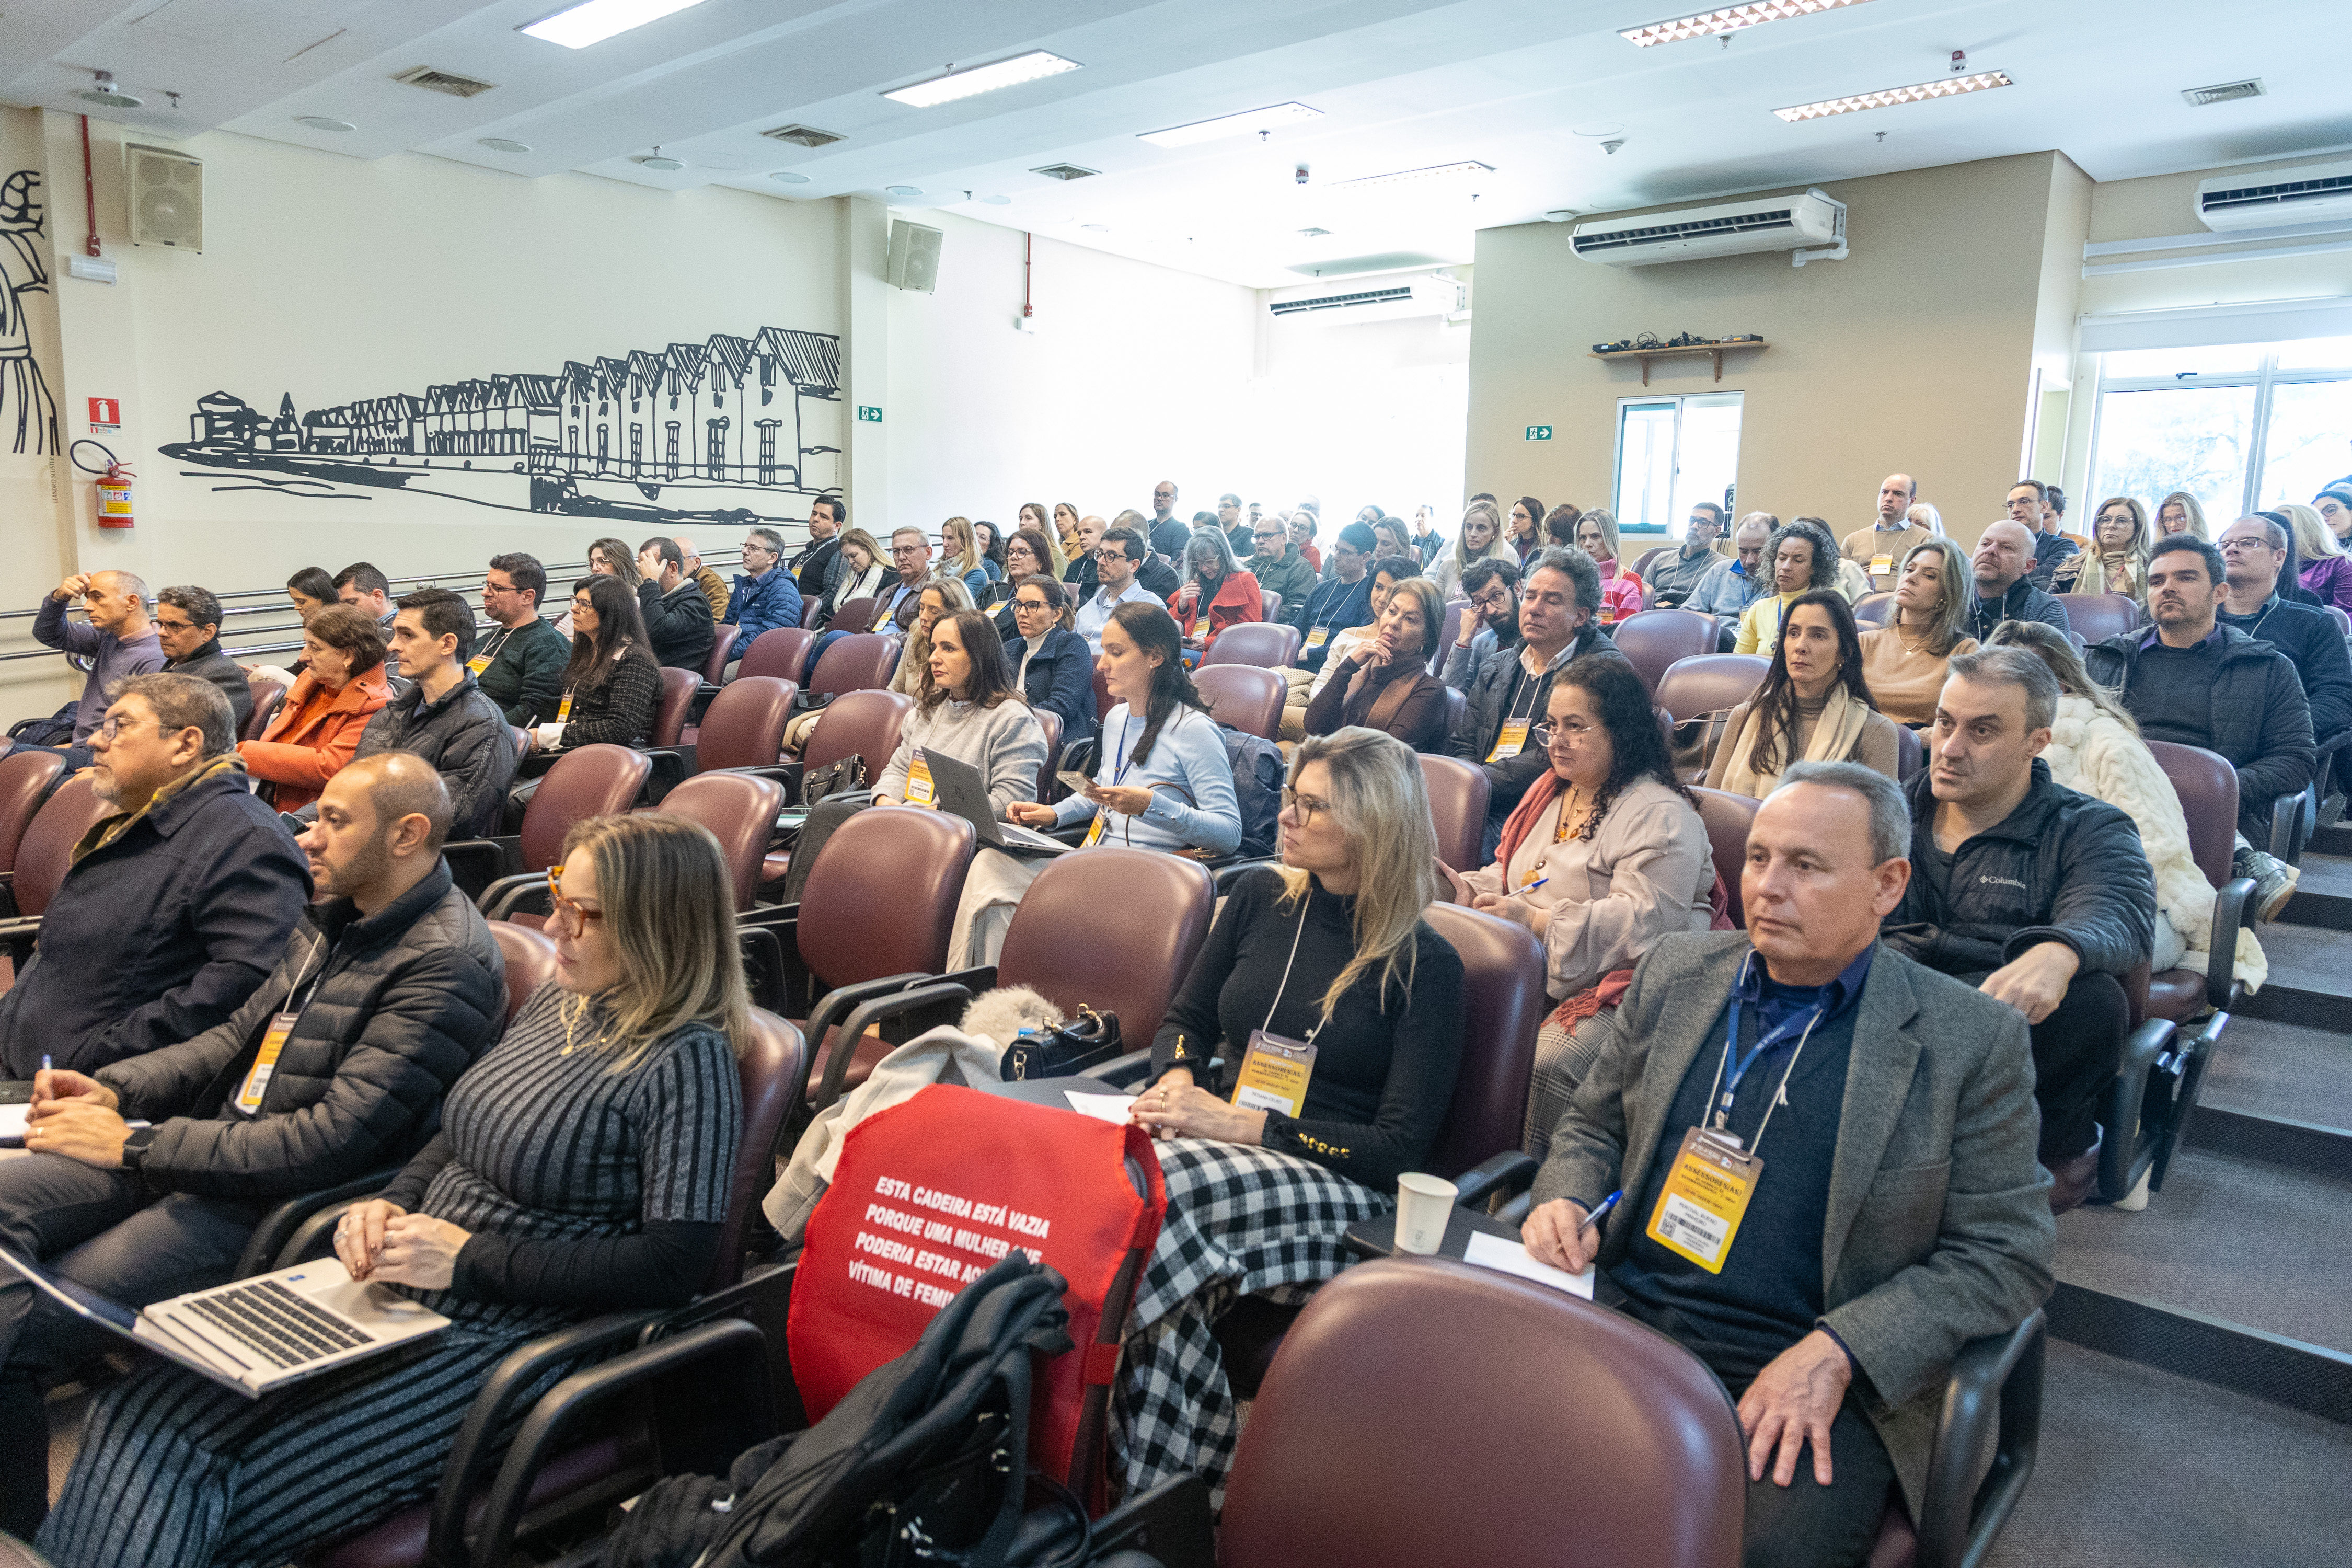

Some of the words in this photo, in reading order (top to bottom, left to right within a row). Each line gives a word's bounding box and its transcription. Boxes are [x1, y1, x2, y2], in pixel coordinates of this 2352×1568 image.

[1988, 875, 2026, 889] Columbia
[1683, 1163, 1743, 1197] ASSESSORES(AS)
[875, 1176, 911, 1201] ESTA
[913, 1186, 972, 1218] CADEIRA
[971, 1205, 1008, 1227] ESTÁ
[1008, 1210, 1050, 1239] VAZIA
[865, 1203, 925, 1236] PORQUE
[924, 1221, 953, 1244] UMA
[953, 1229, 1010, 1259] MULHER
[855, 1231, 915, 1265] PODERIA
[914, 1250, 961, 1280] ESTAR
[849, 1259, 892, 1291] VÍTIMA
[893, 1275, 914, 1298] DE
